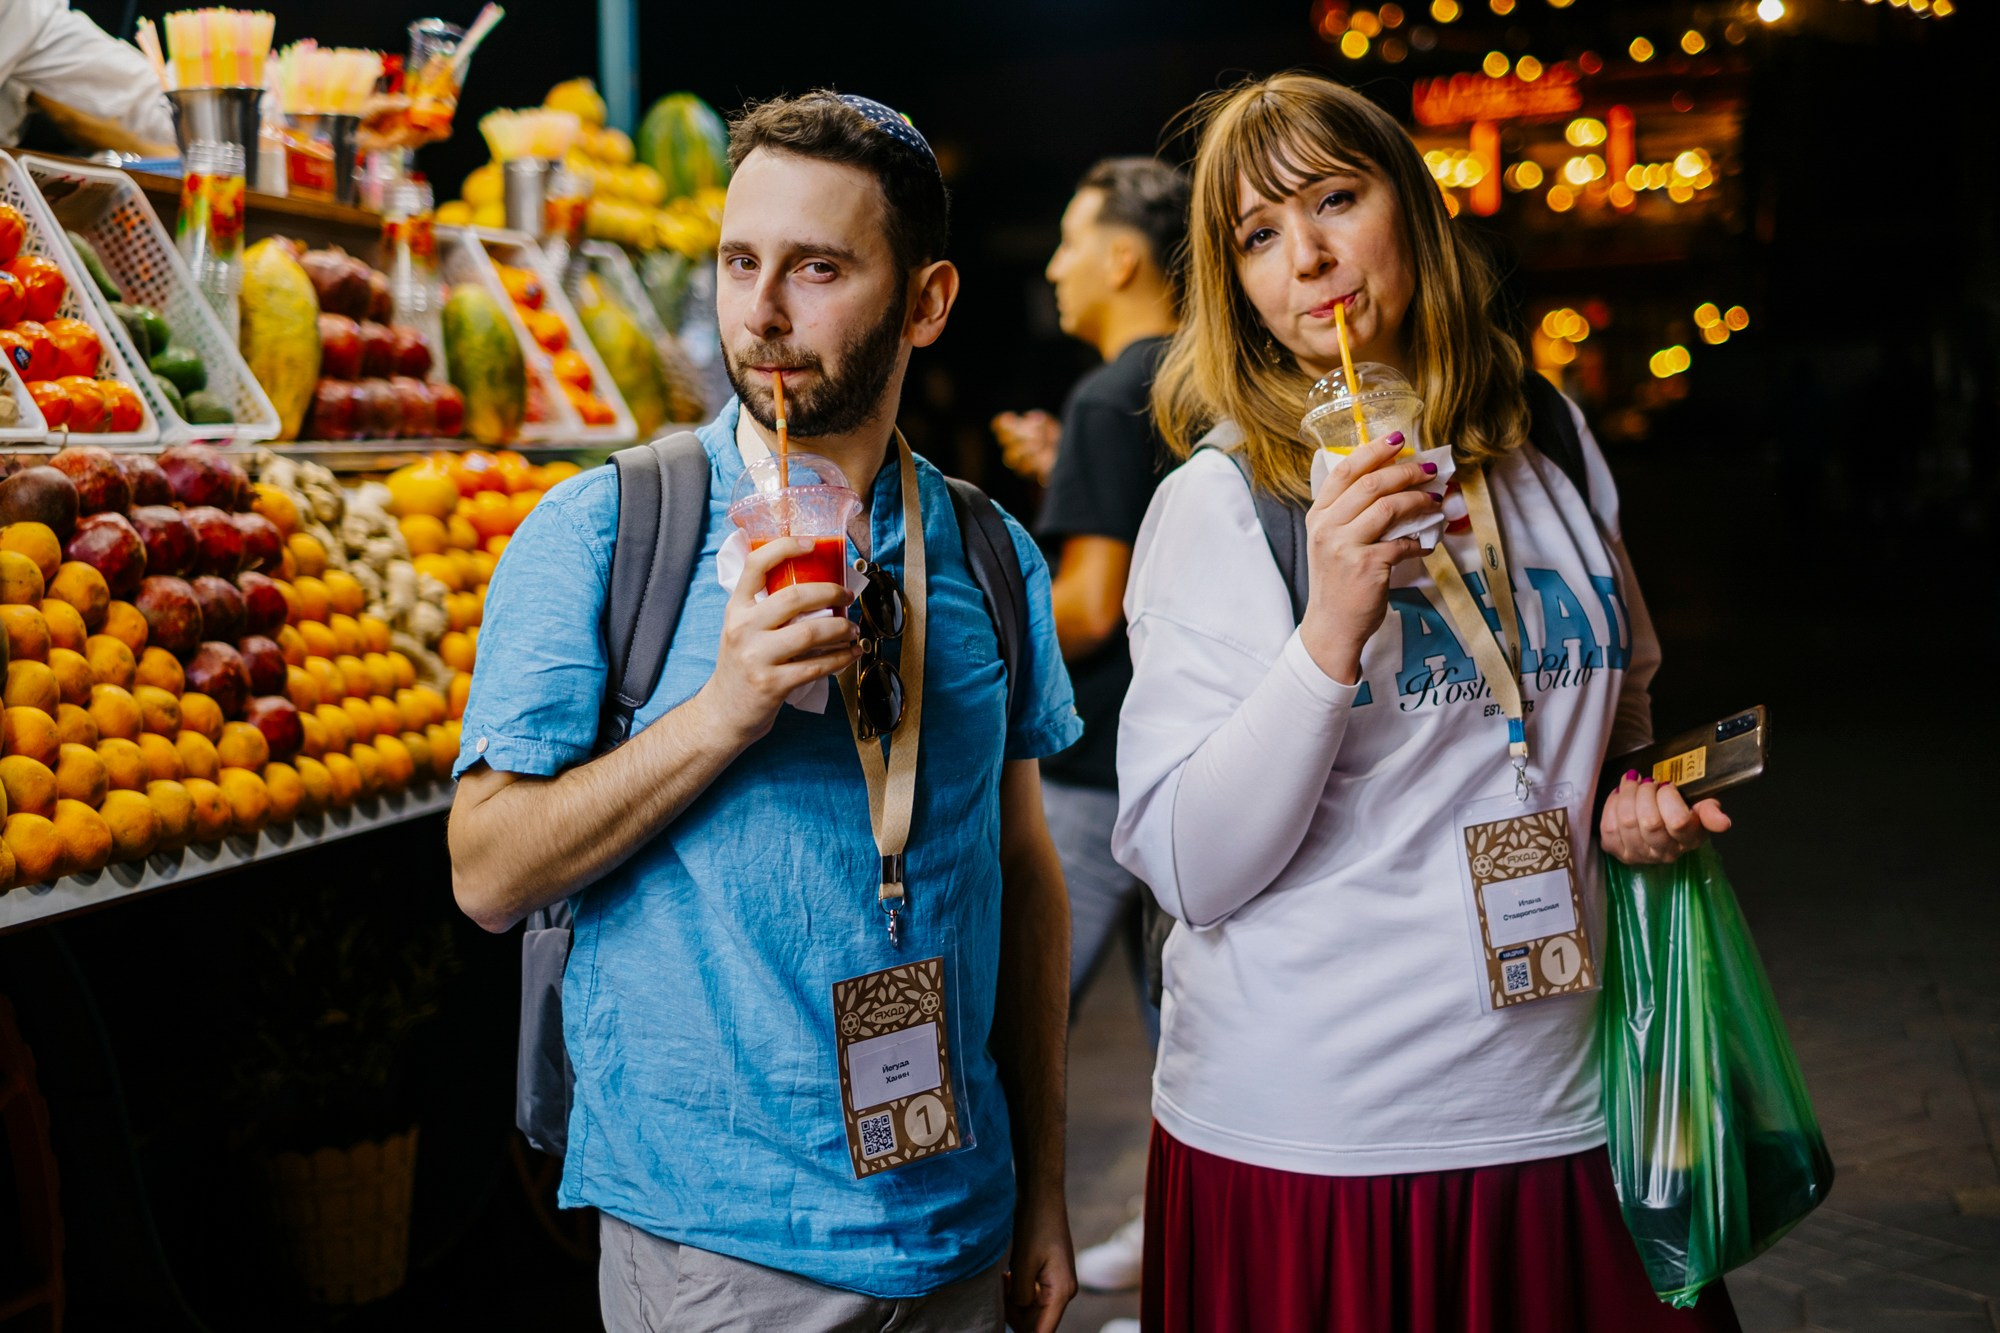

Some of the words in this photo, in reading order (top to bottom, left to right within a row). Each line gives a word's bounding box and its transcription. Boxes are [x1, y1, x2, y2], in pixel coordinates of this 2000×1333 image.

[1351, 566, 1633, 707] AHAD
[1536, 651, 1597, 692] Club
[874, 1005, 906, 1022] ЯХАД
